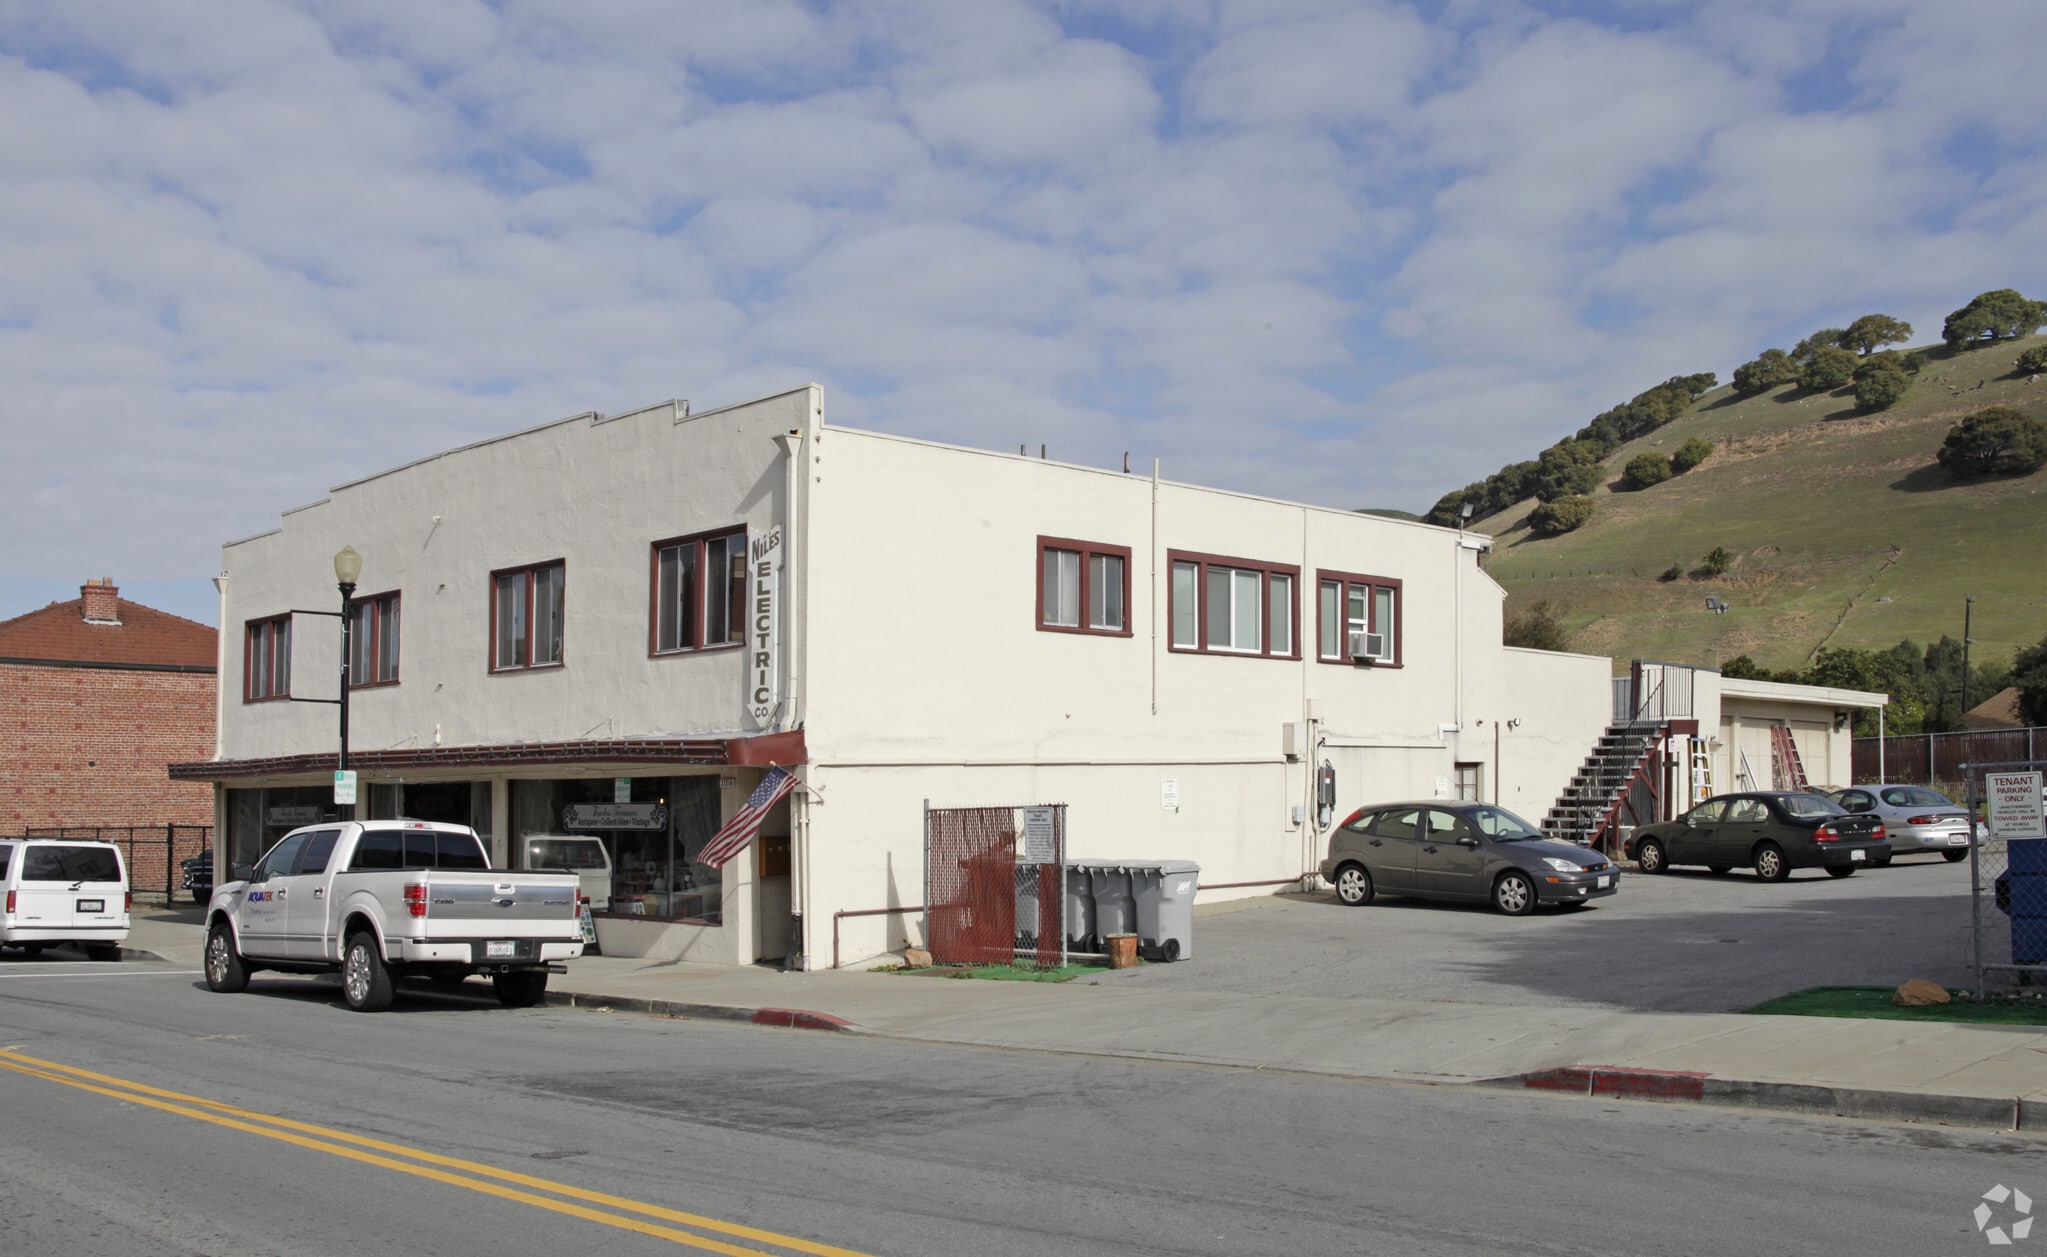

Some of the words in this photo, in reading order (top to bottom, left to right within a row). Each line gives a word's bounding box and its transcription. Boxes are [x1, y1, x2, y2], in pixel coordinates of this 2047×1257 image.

[752, 531, 780, 564] NILES
[754, 561, 771, 705] ELECTRIC
[1994, 776, 2034, 786] TENANT
[1996, 786, 2033, 794] PARKING
[248, 891, 274, 903] AQUATEK
